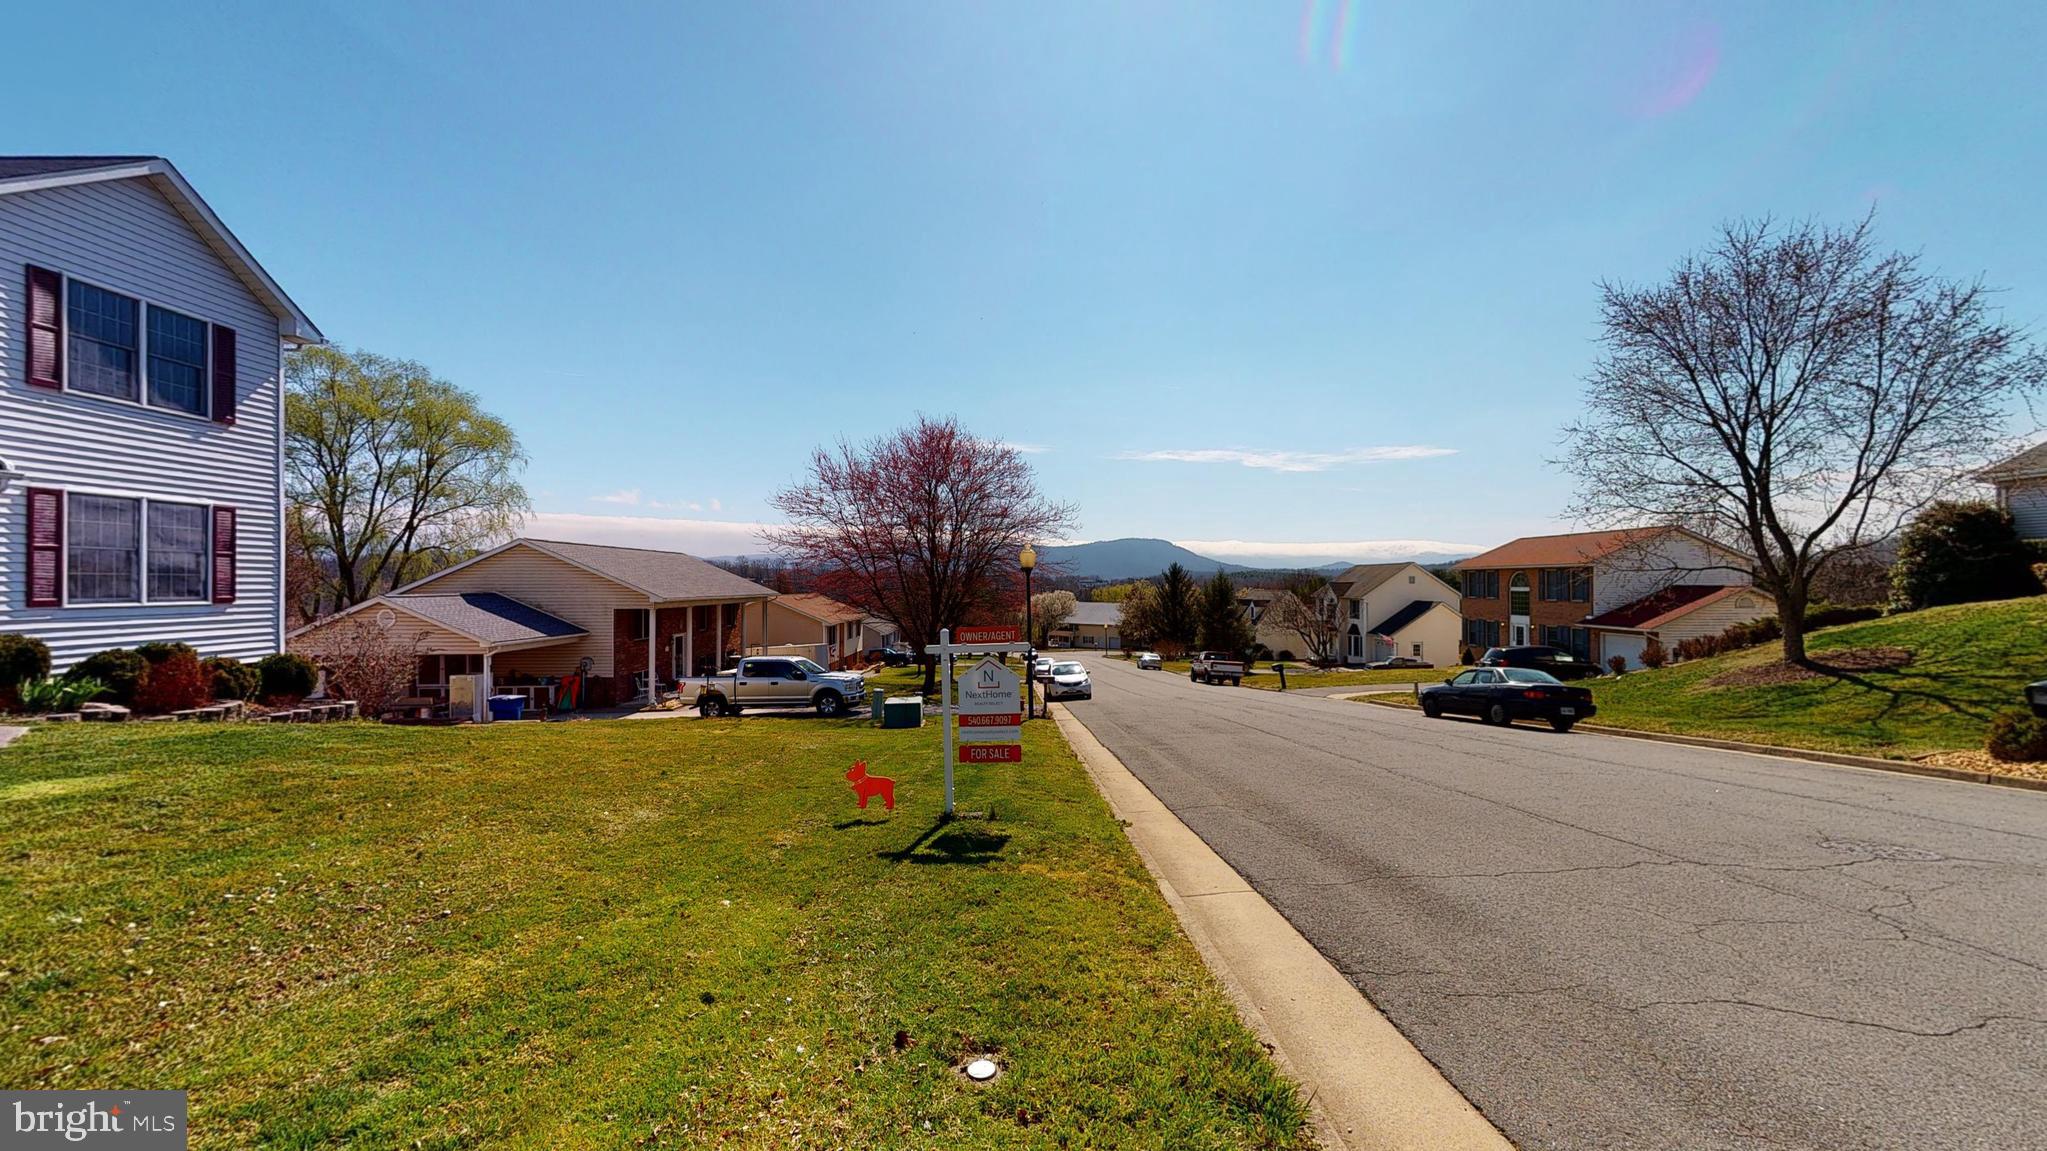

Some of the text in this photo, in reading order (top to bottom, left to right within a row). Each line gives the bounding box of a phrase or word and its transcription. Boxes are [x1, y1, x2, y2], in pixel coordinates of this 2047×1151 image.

[960, 631, 1015, 642] OWNER/AGENT
[983, 670, 994, 682] N
[965, 690, 1013, 699] NextHome
[968, 715, 1012, 725] 540.667.9097
[971, 748, 1010, 759] FOR SALE
